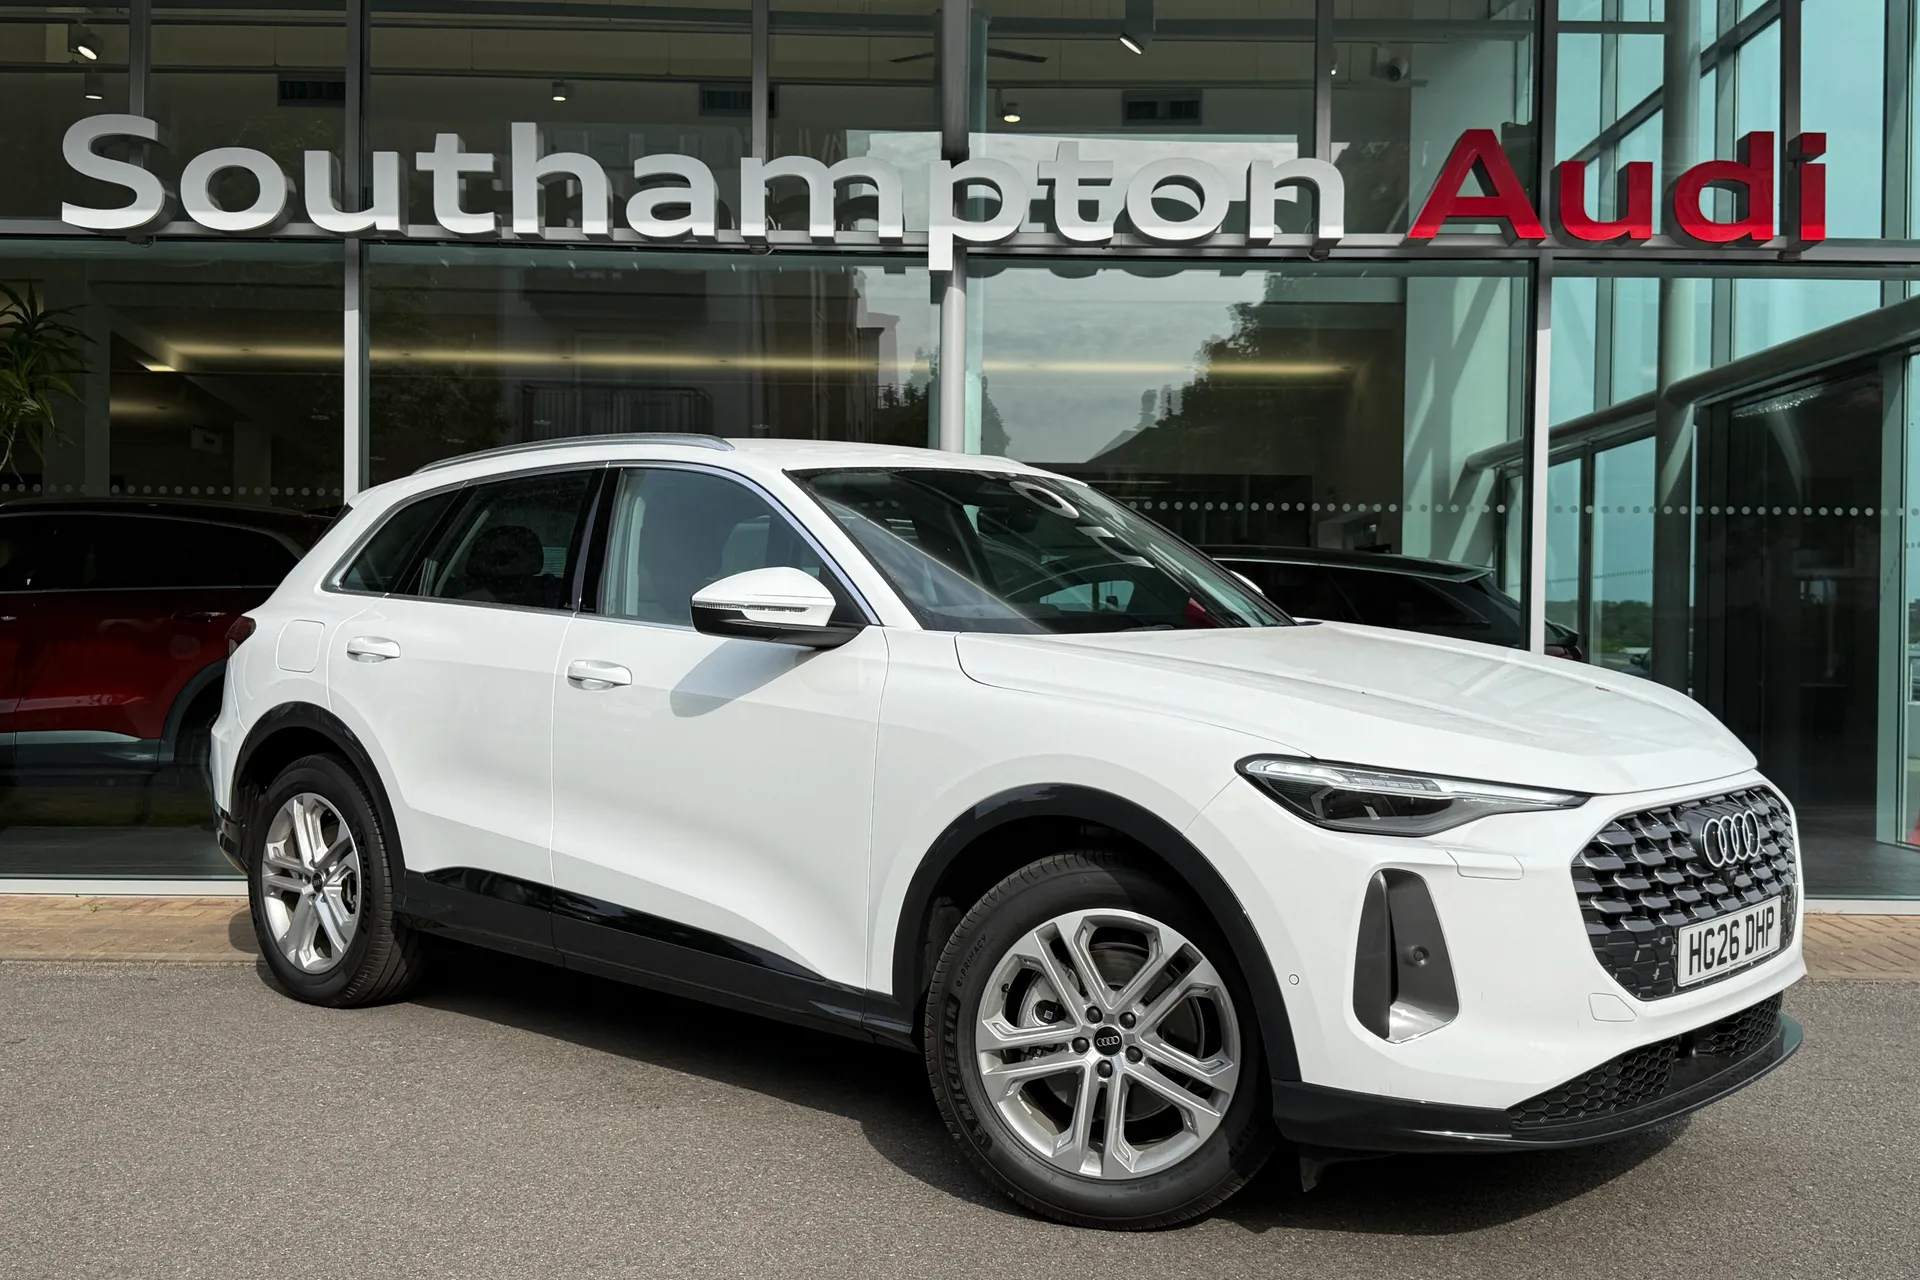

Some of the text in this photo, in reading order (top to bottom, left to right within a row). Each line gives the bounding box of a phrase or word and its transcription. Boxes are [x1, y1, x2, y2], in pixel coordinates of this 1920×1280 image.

[61, 114, 1827, 271] Southampton Audi
[1688, 906, 1775, 976] HG26 DHP
[945, 1000, 975, 1121] MICHELIN
